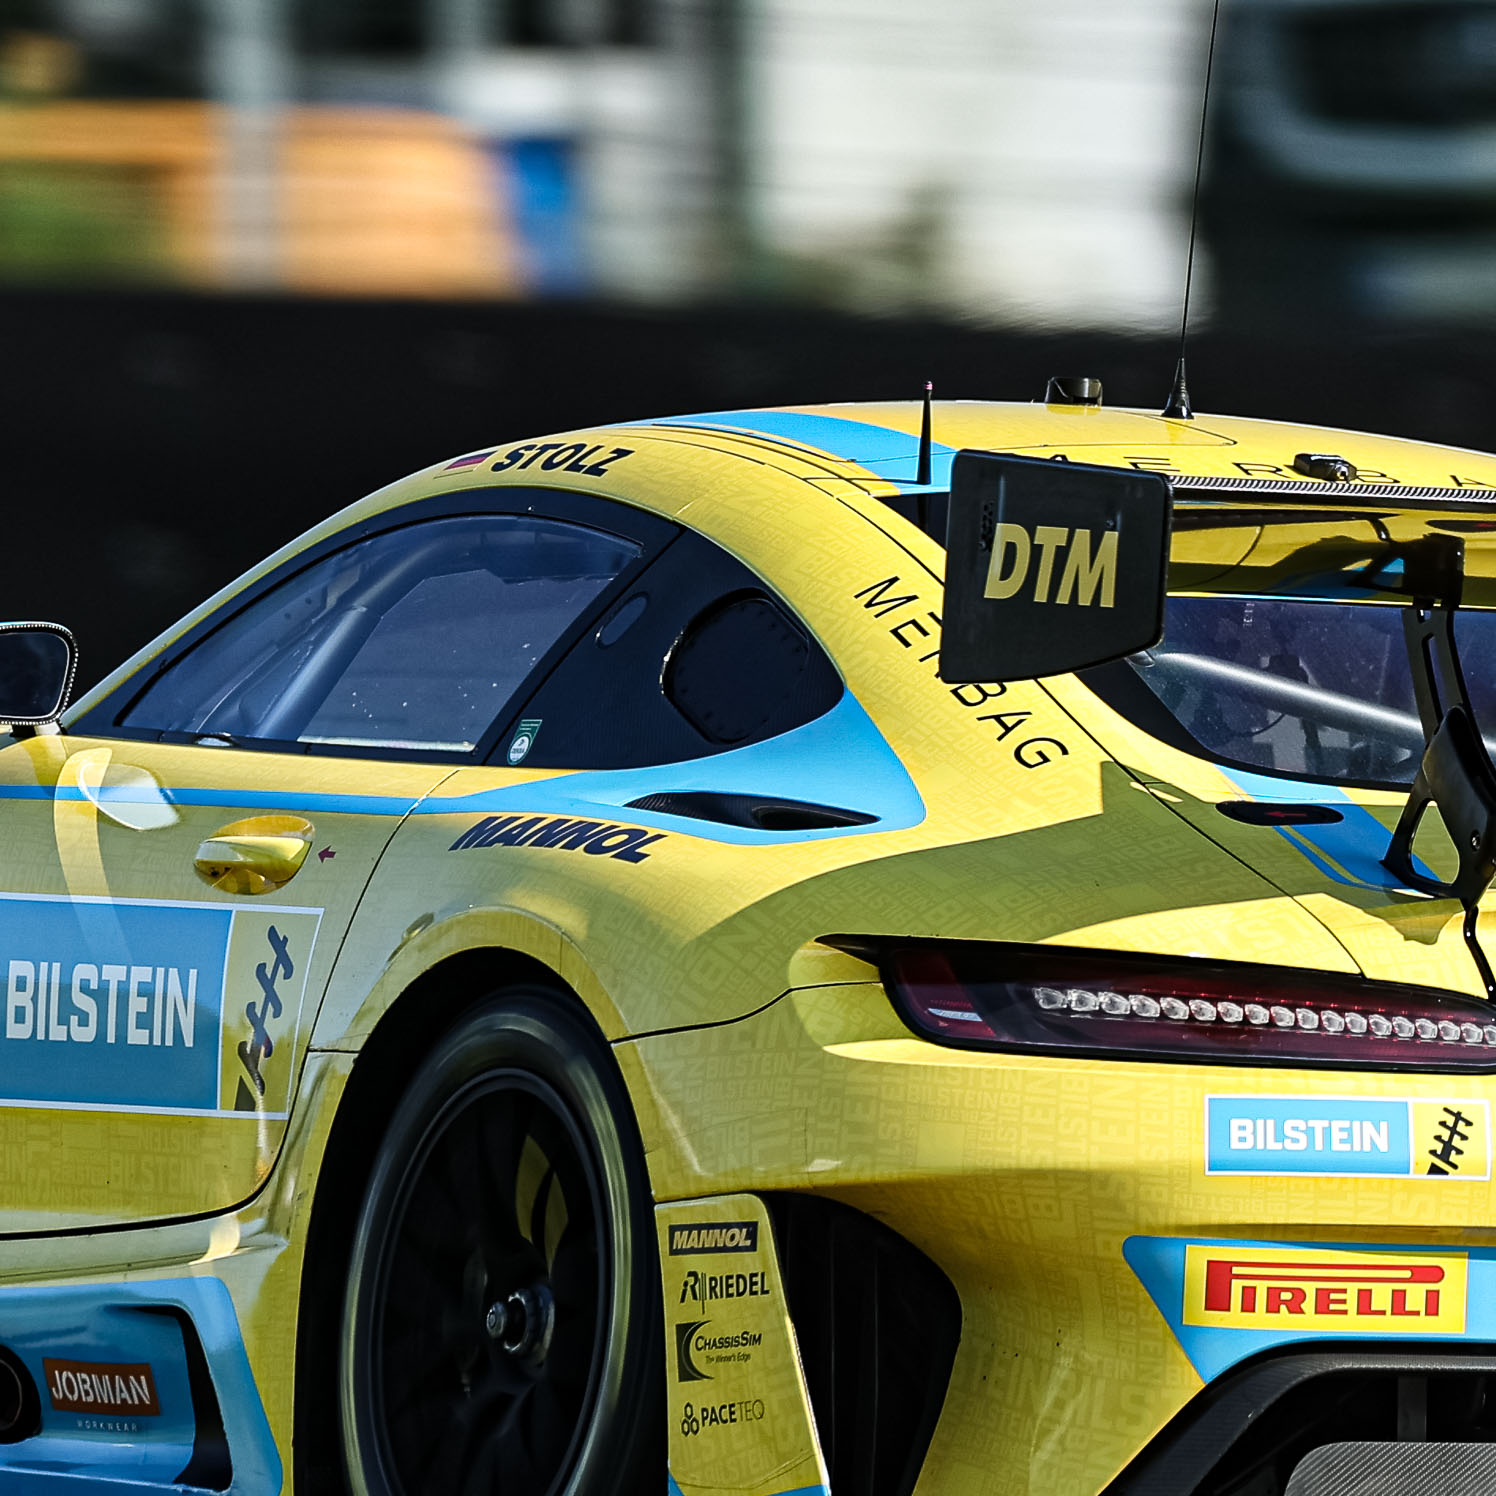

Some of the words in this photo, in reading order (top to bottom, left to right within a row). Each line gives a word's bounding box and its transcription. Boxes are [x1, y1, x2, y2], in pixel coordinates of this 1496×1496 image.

[491, 443, 635, 477] STOLZ
[984, 523, 1118, 607] DTM
[448, 816, 667, 864] MANNOL
[6, 960, 197, 1047] BILSTEIN
[1230, 1118, 1389, 1153] BILSTEIN
[673, 1228, 751, 1249] MANNOL
[709, 1272, 770, 1300] RIEDEL
[1204, 1260, 1445, 1316] PIRELLI
[52, 1370, 150, 1404] JOBMAN
[77, 1420, 137, 1431] WORKWEAR
[701, 1400, 764, 1426] PACETEQ
